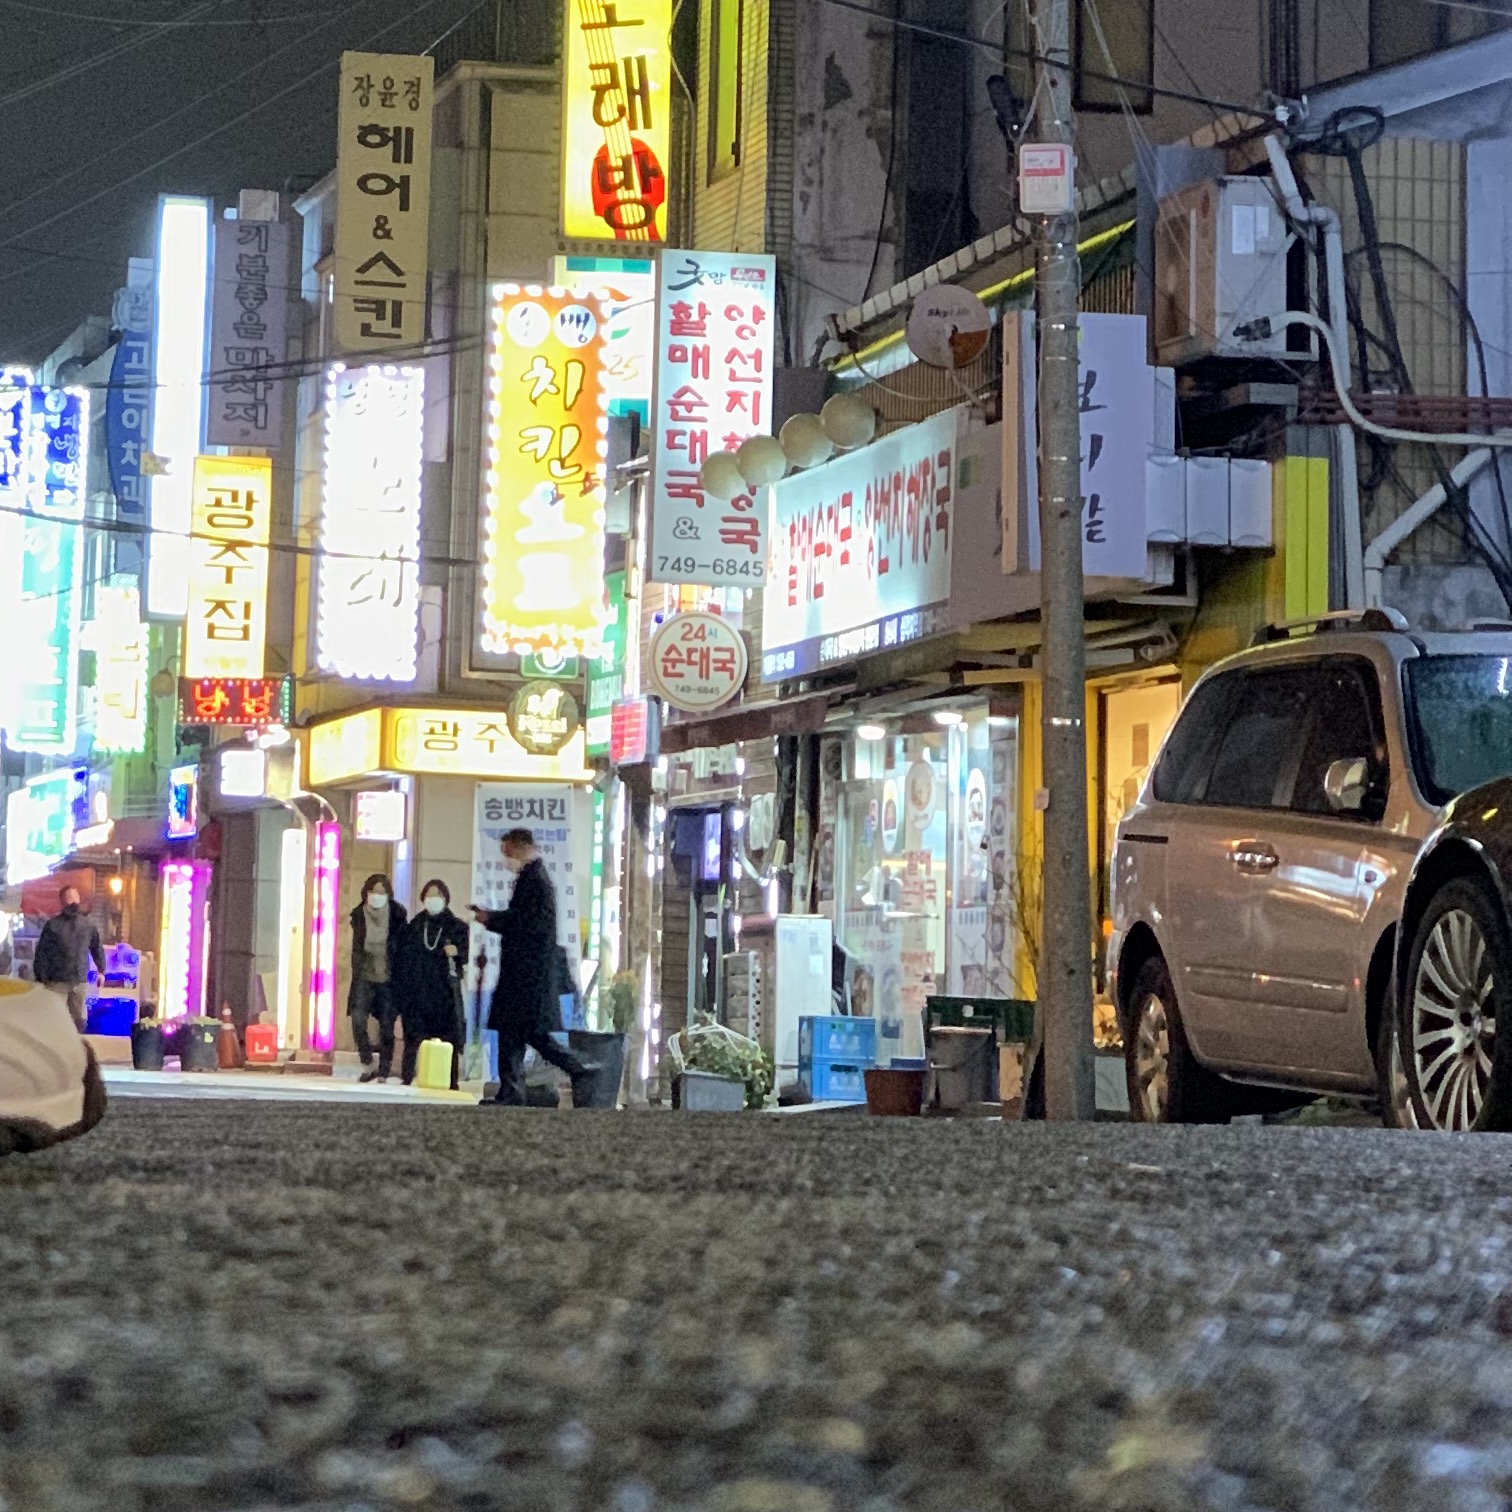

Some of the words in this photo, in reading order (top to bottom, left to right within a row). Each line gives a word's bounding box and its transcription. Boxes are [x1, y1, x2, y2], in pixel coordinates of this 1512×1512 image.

[352, 74, 422, 112] 장윤경
[221, 345, 276, 430] 마사지
[519, 354, 587, 480] 치킨
[719, 304, 766, 555] 양선지국
[672, 515, 701, 541] &
[203, 487, 260, 642] 광주집
[657, 555, 764, 578] 749-6845
[660, 642, 737, 682] 순대국
[423, 719, 510, 754] 광주
[484, 797, 566, 822] 송뱅치킨
